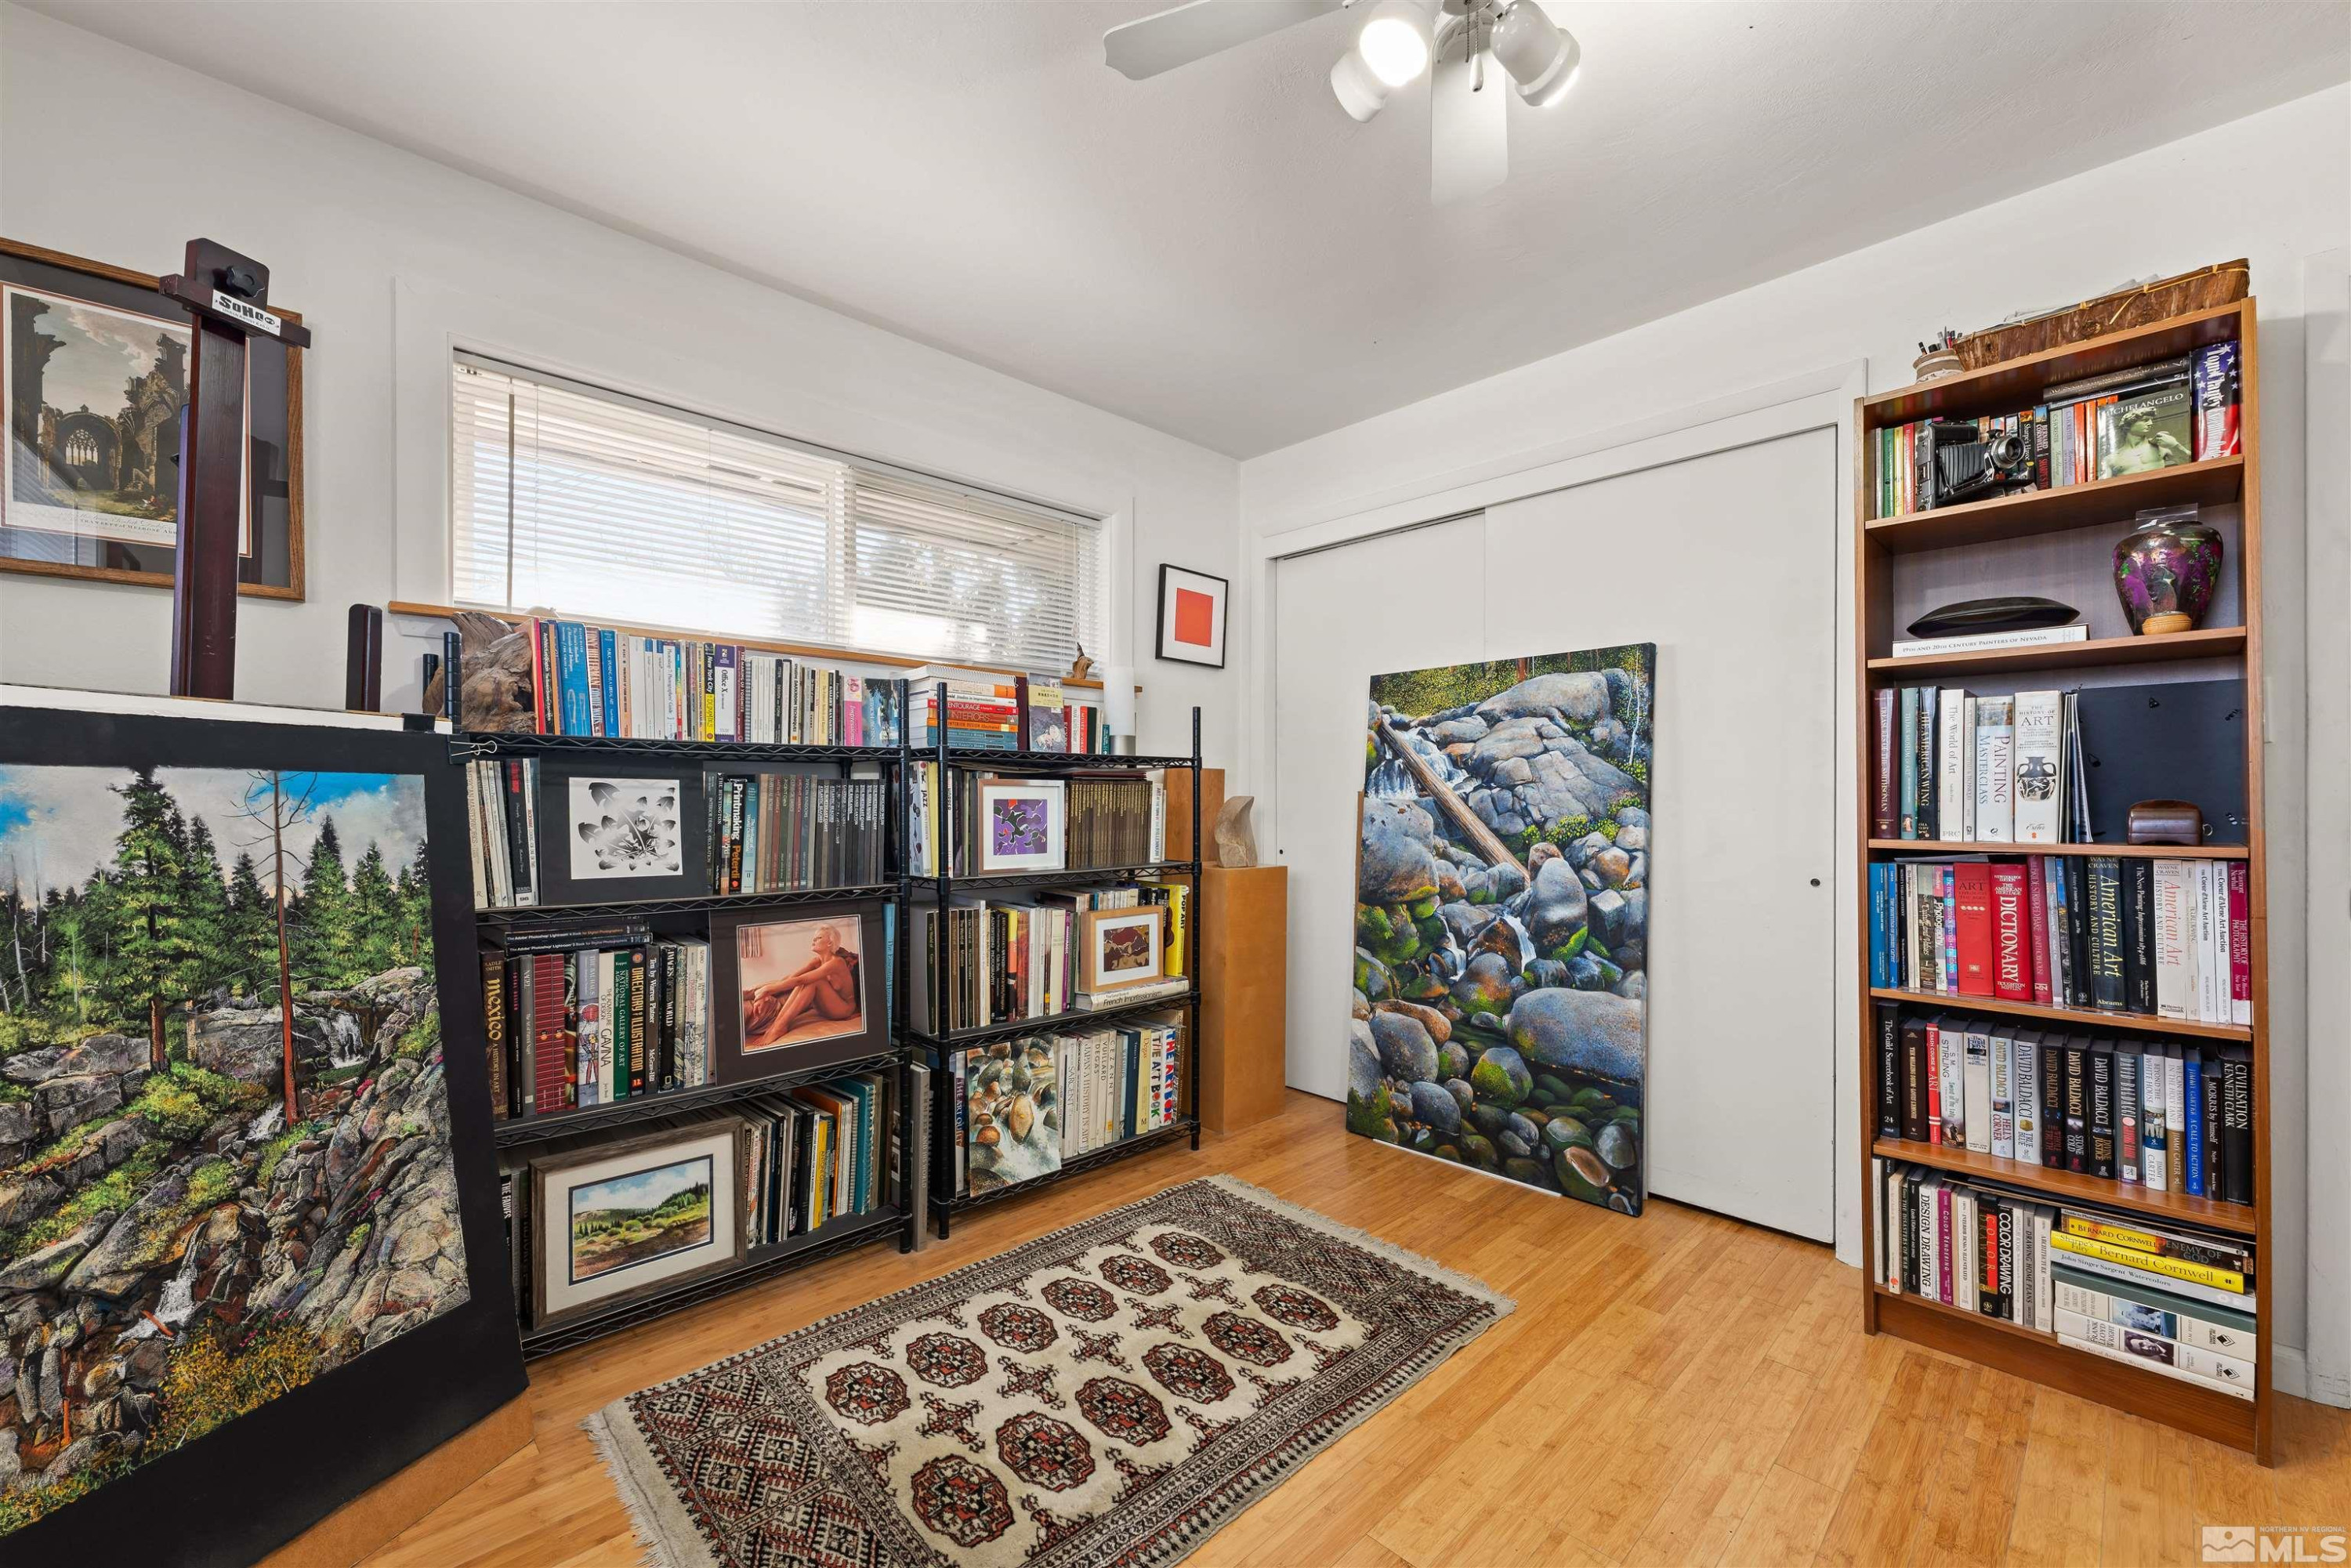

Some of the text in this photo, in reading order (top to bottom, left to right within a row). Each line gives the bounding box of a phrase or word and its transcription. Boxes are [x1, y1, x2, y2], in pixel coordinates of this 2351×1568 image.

[588, 649, 602, 686] HILLERMAN
[947, 701, 980, 711] ENTOURAGE
[951, 711, 991, 722] INTERIORS
[2021, 715, 2054, 726] ART
[1948, 705, 1958, 774] The World of Art
[1978, 735, 1991, 805] MASTERCLASS
[1994, 735, 2011, 804] PAINTING
[921, 790, 929, 808] JAZZ
[469, 799, 478, 844] MASTERWORKS
[730, 783, 744, 878] Printmaking Peterdi
[1960, 882, 1984, 891] ART
[1999, 896, 2019, 983] DICTIONARY
[2088, 875, 2101, 976] HISTORY AND CULTURE
[2100, 875, 2124, 978] American Art
[2164, 881, 2183, 967] American Art
[2219, 930, 2228, 954] Auction
[2232, 918, 2241, 964] PHOTOGRAPHY
[2240, 932, 2248, 958] HISTORY
[648, 970, 657, 979] by
[665, 951, 675, 1027] IMAGES WORLD
[486, 978, 505, 1041] mexico
[600, 994, 606, 1003] OF
[1102, 990, 1163, 1007] French Impressionism
[631, 967, 644, 1072] DIRECTORY ILLUSTRATION
[600, 1028, 613, 1067] GAVINA
[619, 1042, 625, 1052] OF
[1142, 1037, 1150, 1059] Degas
[1885, 1020, 1894, 1104] The Guild Sourcebook Art
[1941, 1039, 1951, 1078] STIRLING
[956, 1081, 965, 1099] THE
[1150, 1035, 1161, 1119] THE ART BOOK
[1164, 1030, 1176, 1123] THE ART BOOK
[1929, 1073, 1939, 1092] ART
[2018, 1045, 2033, 1119] DAVID BALDACCI
[2046, 1050, 2059, 1109] DAVID BALDACCI
[2068, 1051, 2081, 1116] DAVID BALDACCI
[2095, 1057, 2109, 1124] DAVID BALDACCI
[2146, 1081, 2154, 1104] HOUSE
[2121, 1081, 2136, 1118] BALDACCI
[2208, 1081, 2218, 1145] MORRIS himself
[2224, 1063, 2235, 1128] KENNETH CLARK
[2235, 1064, 2248, 1130] CIVILISATION
[955, 1117, 965, 1146] QUILT
[1082, 1117, 1089, 1127] IN
[1993, 1114, 2002, 1141] CORNER
[2002, 1117, 2012, 1141] HELL'S
[2067, 1135, 2076, 1153] COLD
[2075, 1135, 2084, 1156] STONE
[2093, 1136, 2103, 1161] JUSTICE
[2173, 1153, 2182, 1175] CARTER
[502, 1181, 512, 1219] THE FAUVES
[1920, 1193, 1933, 1287] DESIGN DRAWING
[1979, 1214, 1988, 1280] DRAWING
[1986, 1215, 1997, 1272] COLOR
[1999, 1212, 2012, 1295] COLOR DRAWING
[2078, 1224, 2203, 1258] BERNARD CORNWELL ENEMY
[2183, 1251, 2210, 1265] GOD
[2060, 1255, 2172, 1287] John Singer Sargent Watercolors
[2099, 1245, 2214, 1283] Bernard Cornwell
[2090, 1321, 2099, 1343] FRANK
[2098, 1323, 2106, 1345] LLOYD
[2106, 1325, 2115, 1347] WRIGHT
